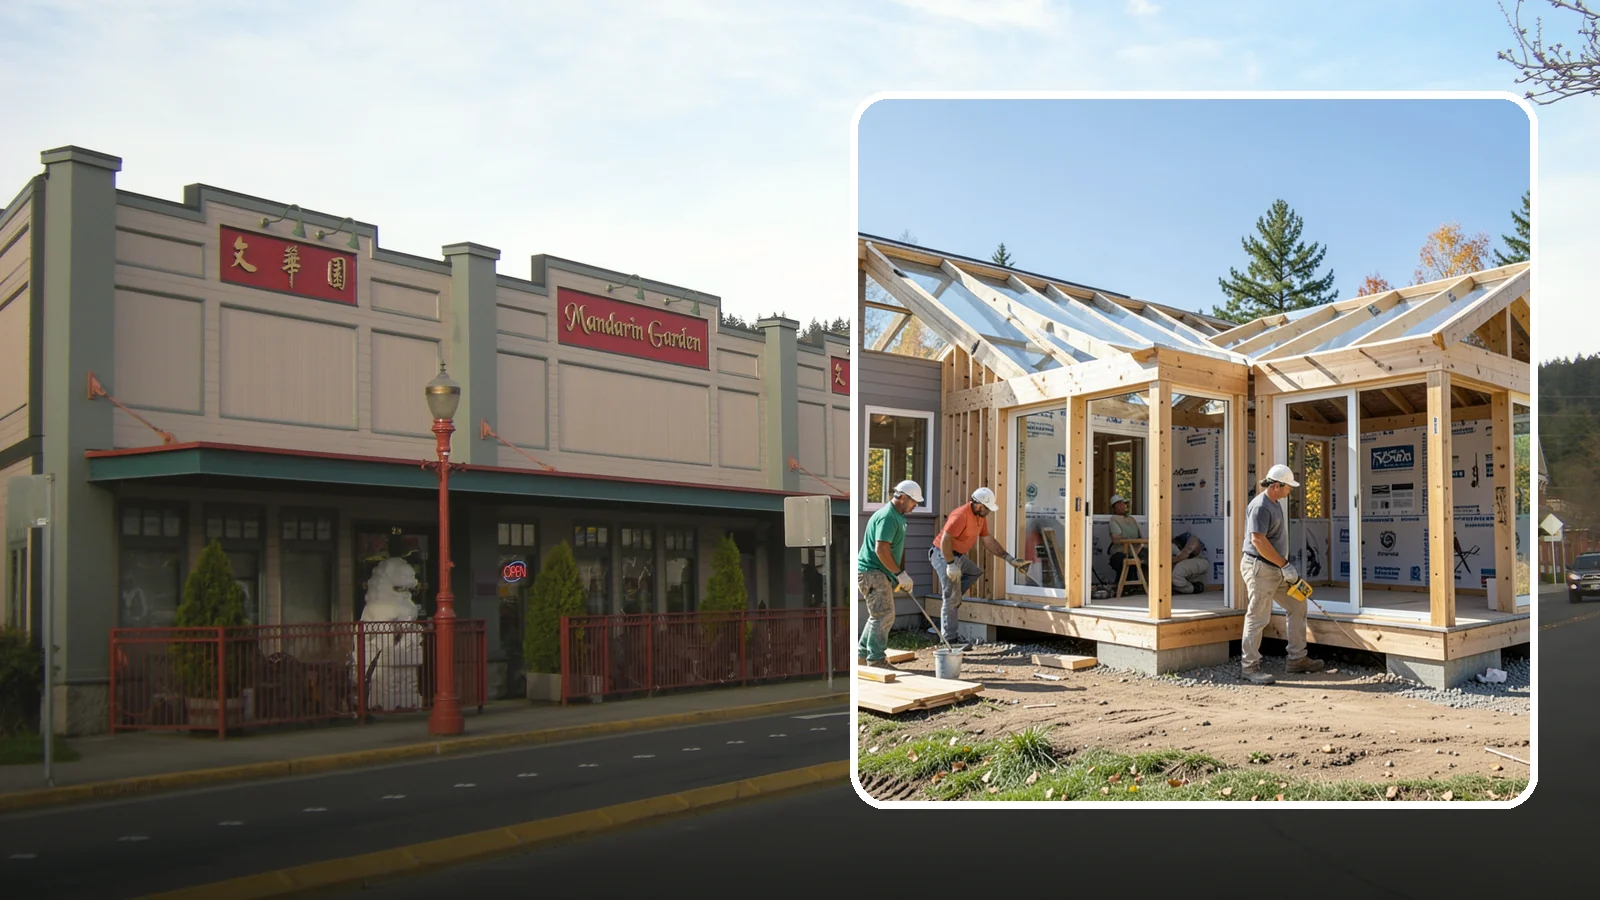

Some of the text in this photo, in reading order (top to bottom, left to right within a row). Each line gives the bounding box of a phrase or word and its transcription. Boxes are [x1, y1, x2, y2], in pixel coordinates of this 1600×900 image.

[564, 302, 701, 352] Mandarin Garden
[503, 564, 527, 578] OPEN
